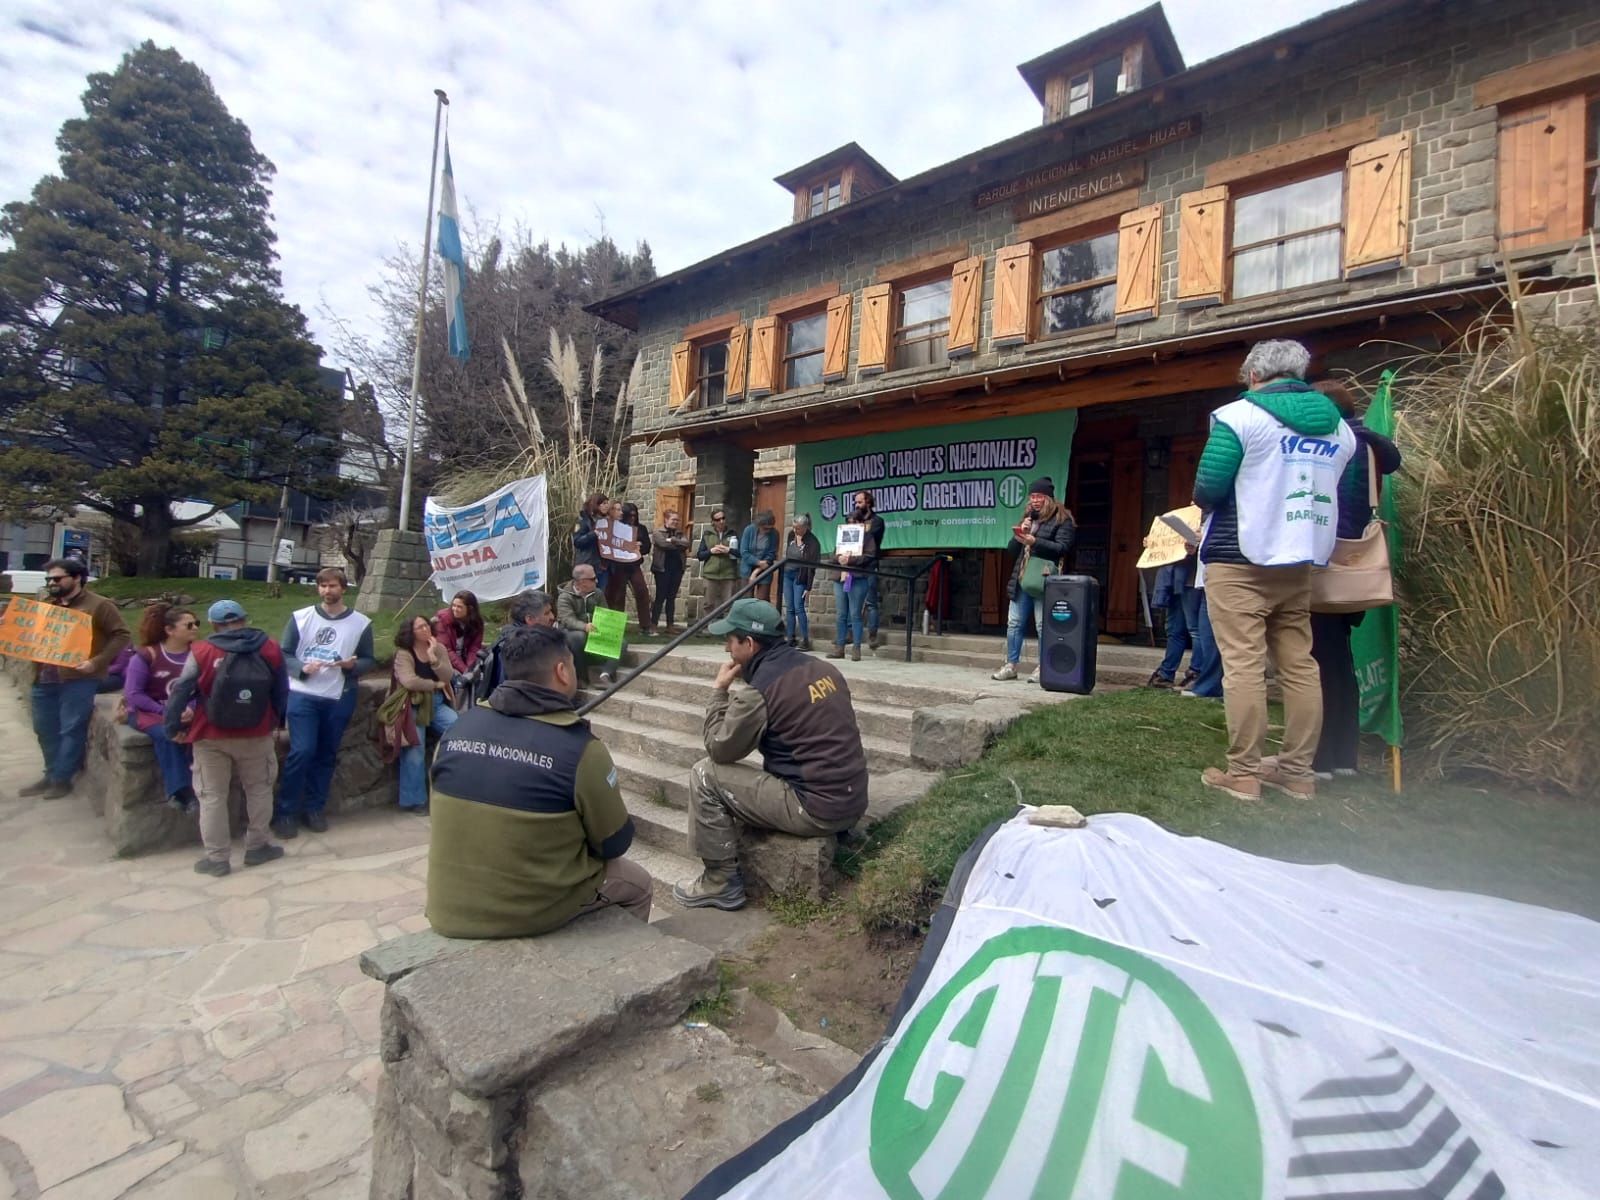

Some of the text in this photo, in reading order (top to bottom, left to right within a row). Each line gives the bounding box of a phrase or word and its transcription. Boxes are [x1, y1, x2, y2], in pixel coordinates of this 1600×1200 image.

[978, 120, 1191, 205] PARQUE NACIONAL NAHUEL HUAPI
[1029, 172, 1124, 214] INTENDENCIA
[813, 437, 1037, 489] DEFENDAMOS PARQUES NACIONALES
[841, 479, 996, 517] DENDAMOS ARGENTINA
[999, 475, 1025, 507] ATE
[14, 616, 72, 638] NO HAY
[807, 675, 838, 704] APN
[446, 740, 554, 769] PARQUES NACIONALES
